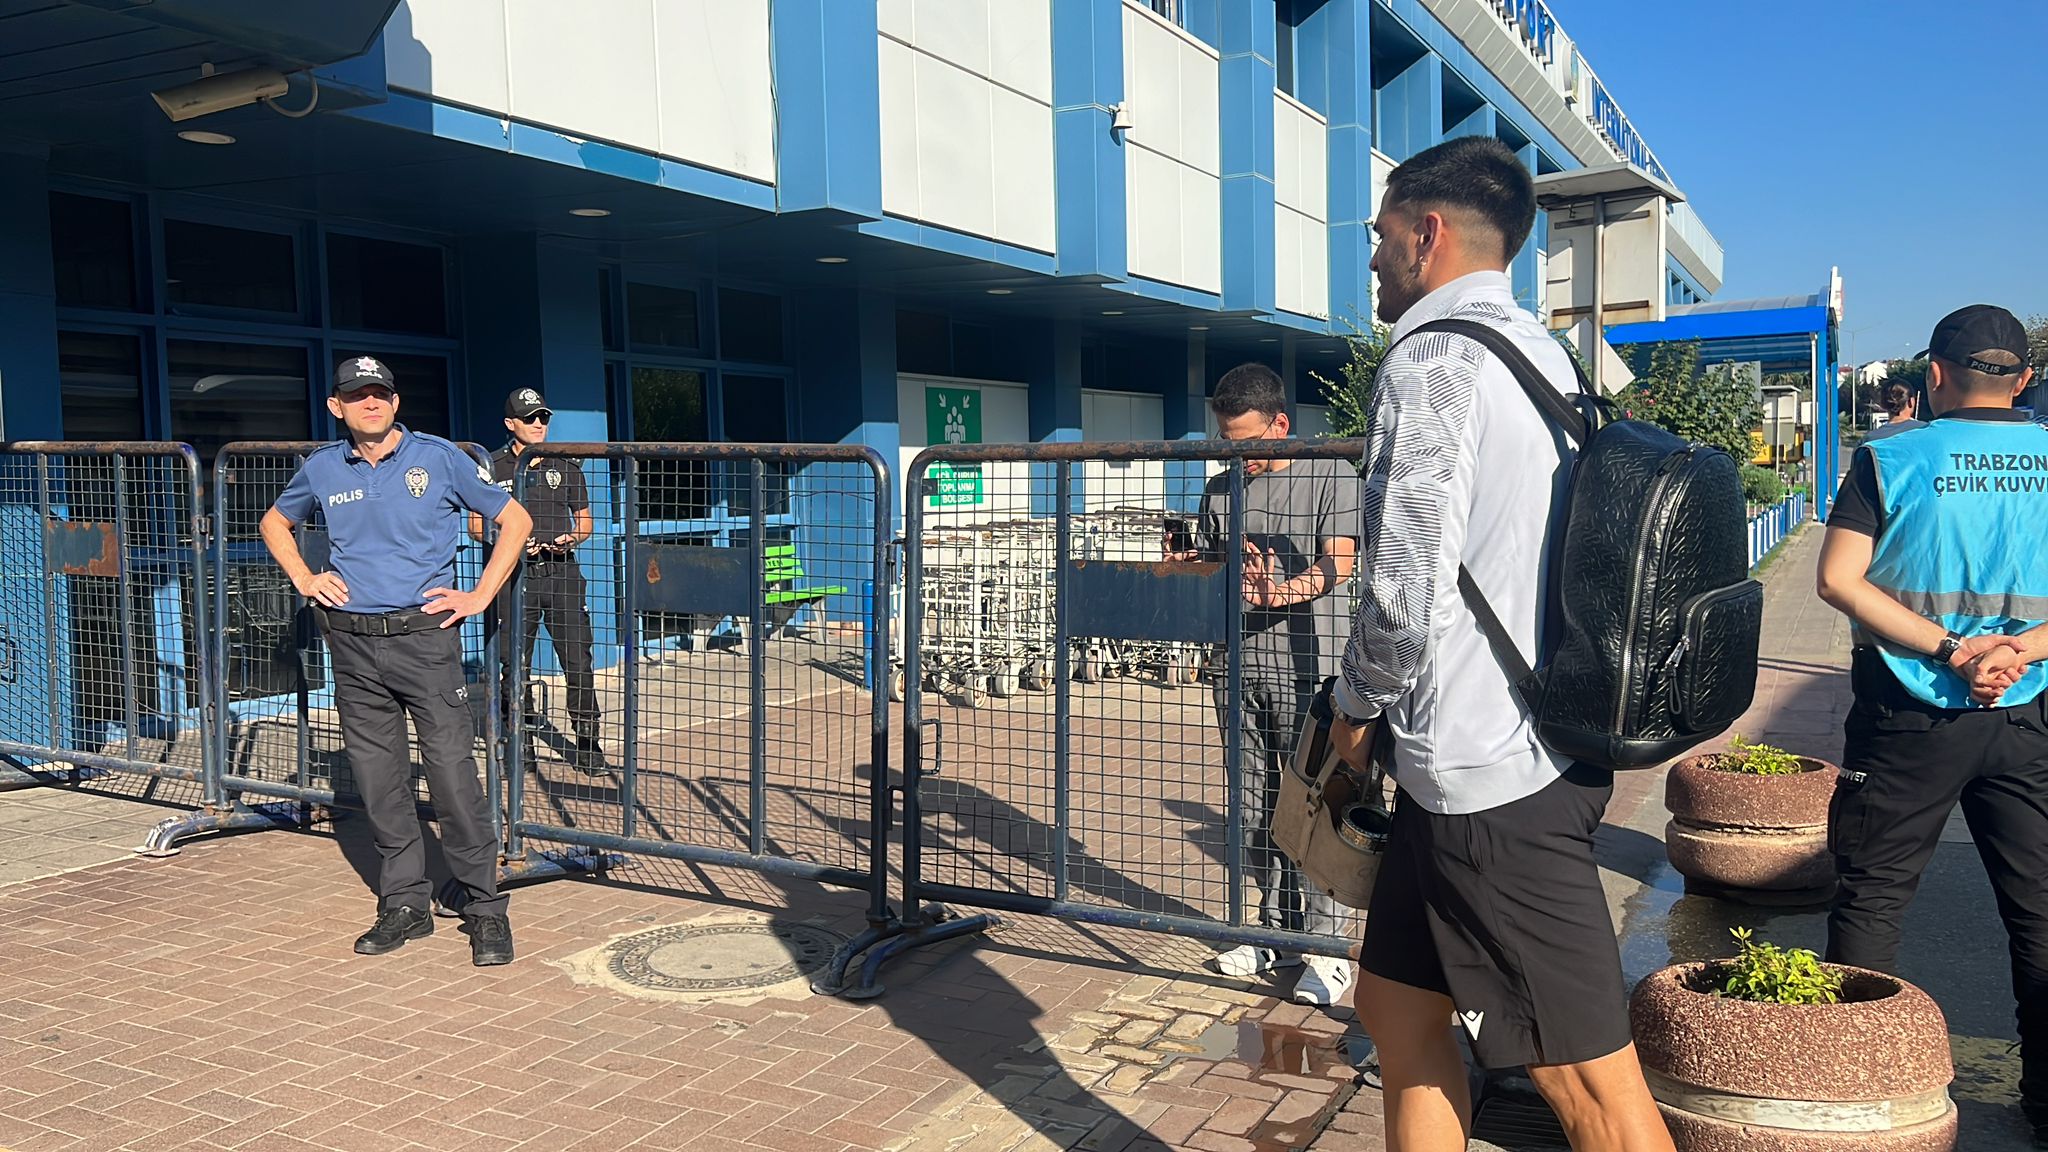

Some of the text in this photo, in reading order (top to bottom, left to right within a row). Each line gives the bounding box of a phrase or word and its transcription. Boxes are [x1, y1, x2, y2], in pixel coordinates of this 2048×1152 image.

[1971, 360, 2001, 373] POLIS
[1949, 453, 2048, 471] TRABZON
[1933, 472, 2048, 498] ÇEVİK KUVV
[328, 488, 364, 507] POLIS
